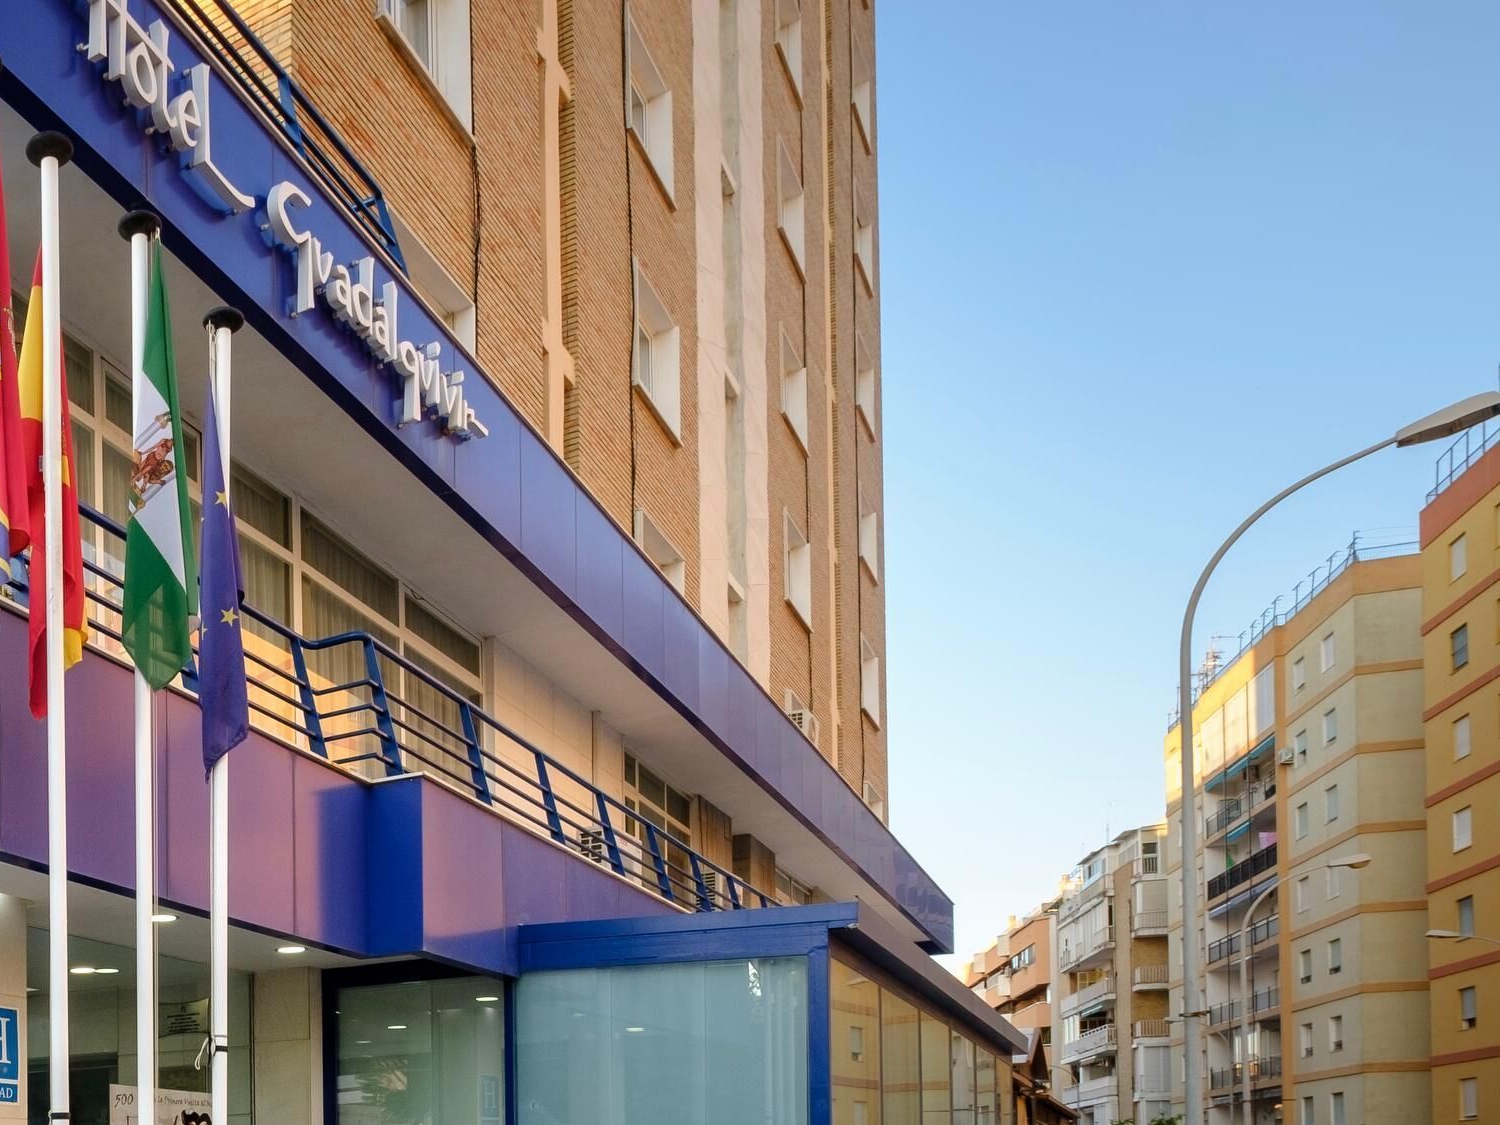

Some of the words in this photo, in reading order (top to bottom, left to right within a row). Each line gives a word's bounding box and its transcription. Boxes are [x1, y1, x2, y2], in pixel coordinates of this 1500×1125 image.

[87, 0, 255, 209] Hotel
[267, 181, 489, 438] Guadalquivir
[115, 1093, 134, 1108] 500
